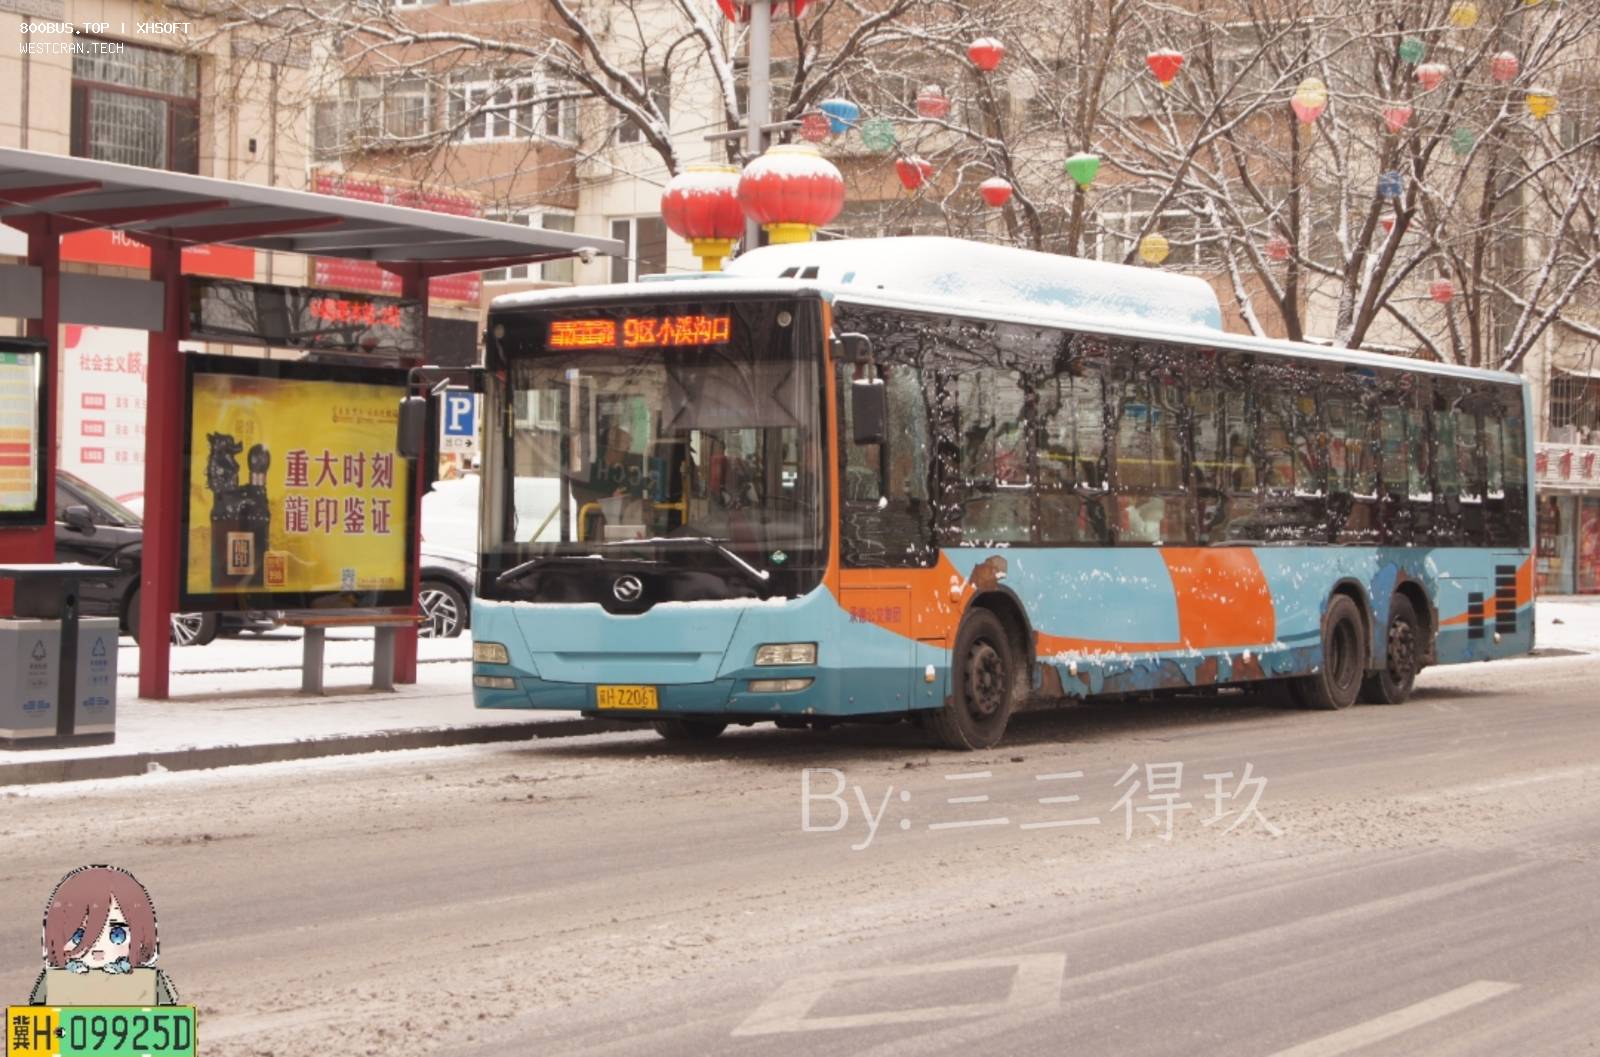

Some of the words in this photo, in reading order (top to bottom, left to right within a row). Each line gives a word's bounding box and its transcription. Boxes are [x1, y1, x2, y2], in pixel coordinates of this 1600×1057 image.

[448, 397, 471, 431] P
[285, 450, 394, 488] 重大时刻
[285, 496, 391, 534] 龍印鉴证
